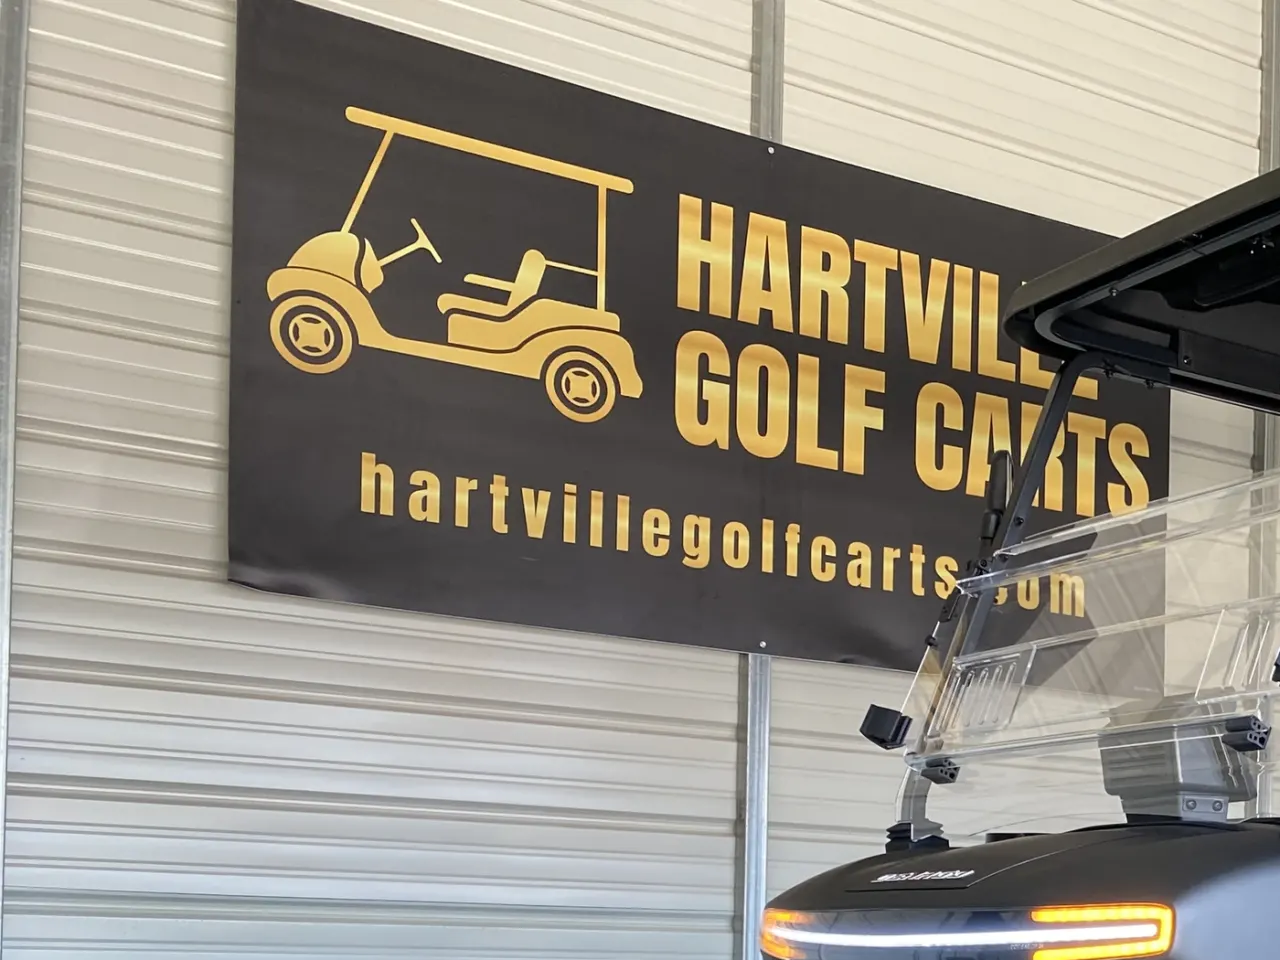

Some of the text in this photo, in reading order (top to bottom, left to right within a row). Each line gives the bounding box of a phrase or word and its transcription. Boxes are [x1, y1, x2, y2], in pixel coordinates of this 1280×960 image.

[676, 193, 1099, 401] HARTVIL
[674, 330, 1151, 518] GOLF CARTS
[360, 451, 1085, 618] hartvillegolfcartsom
